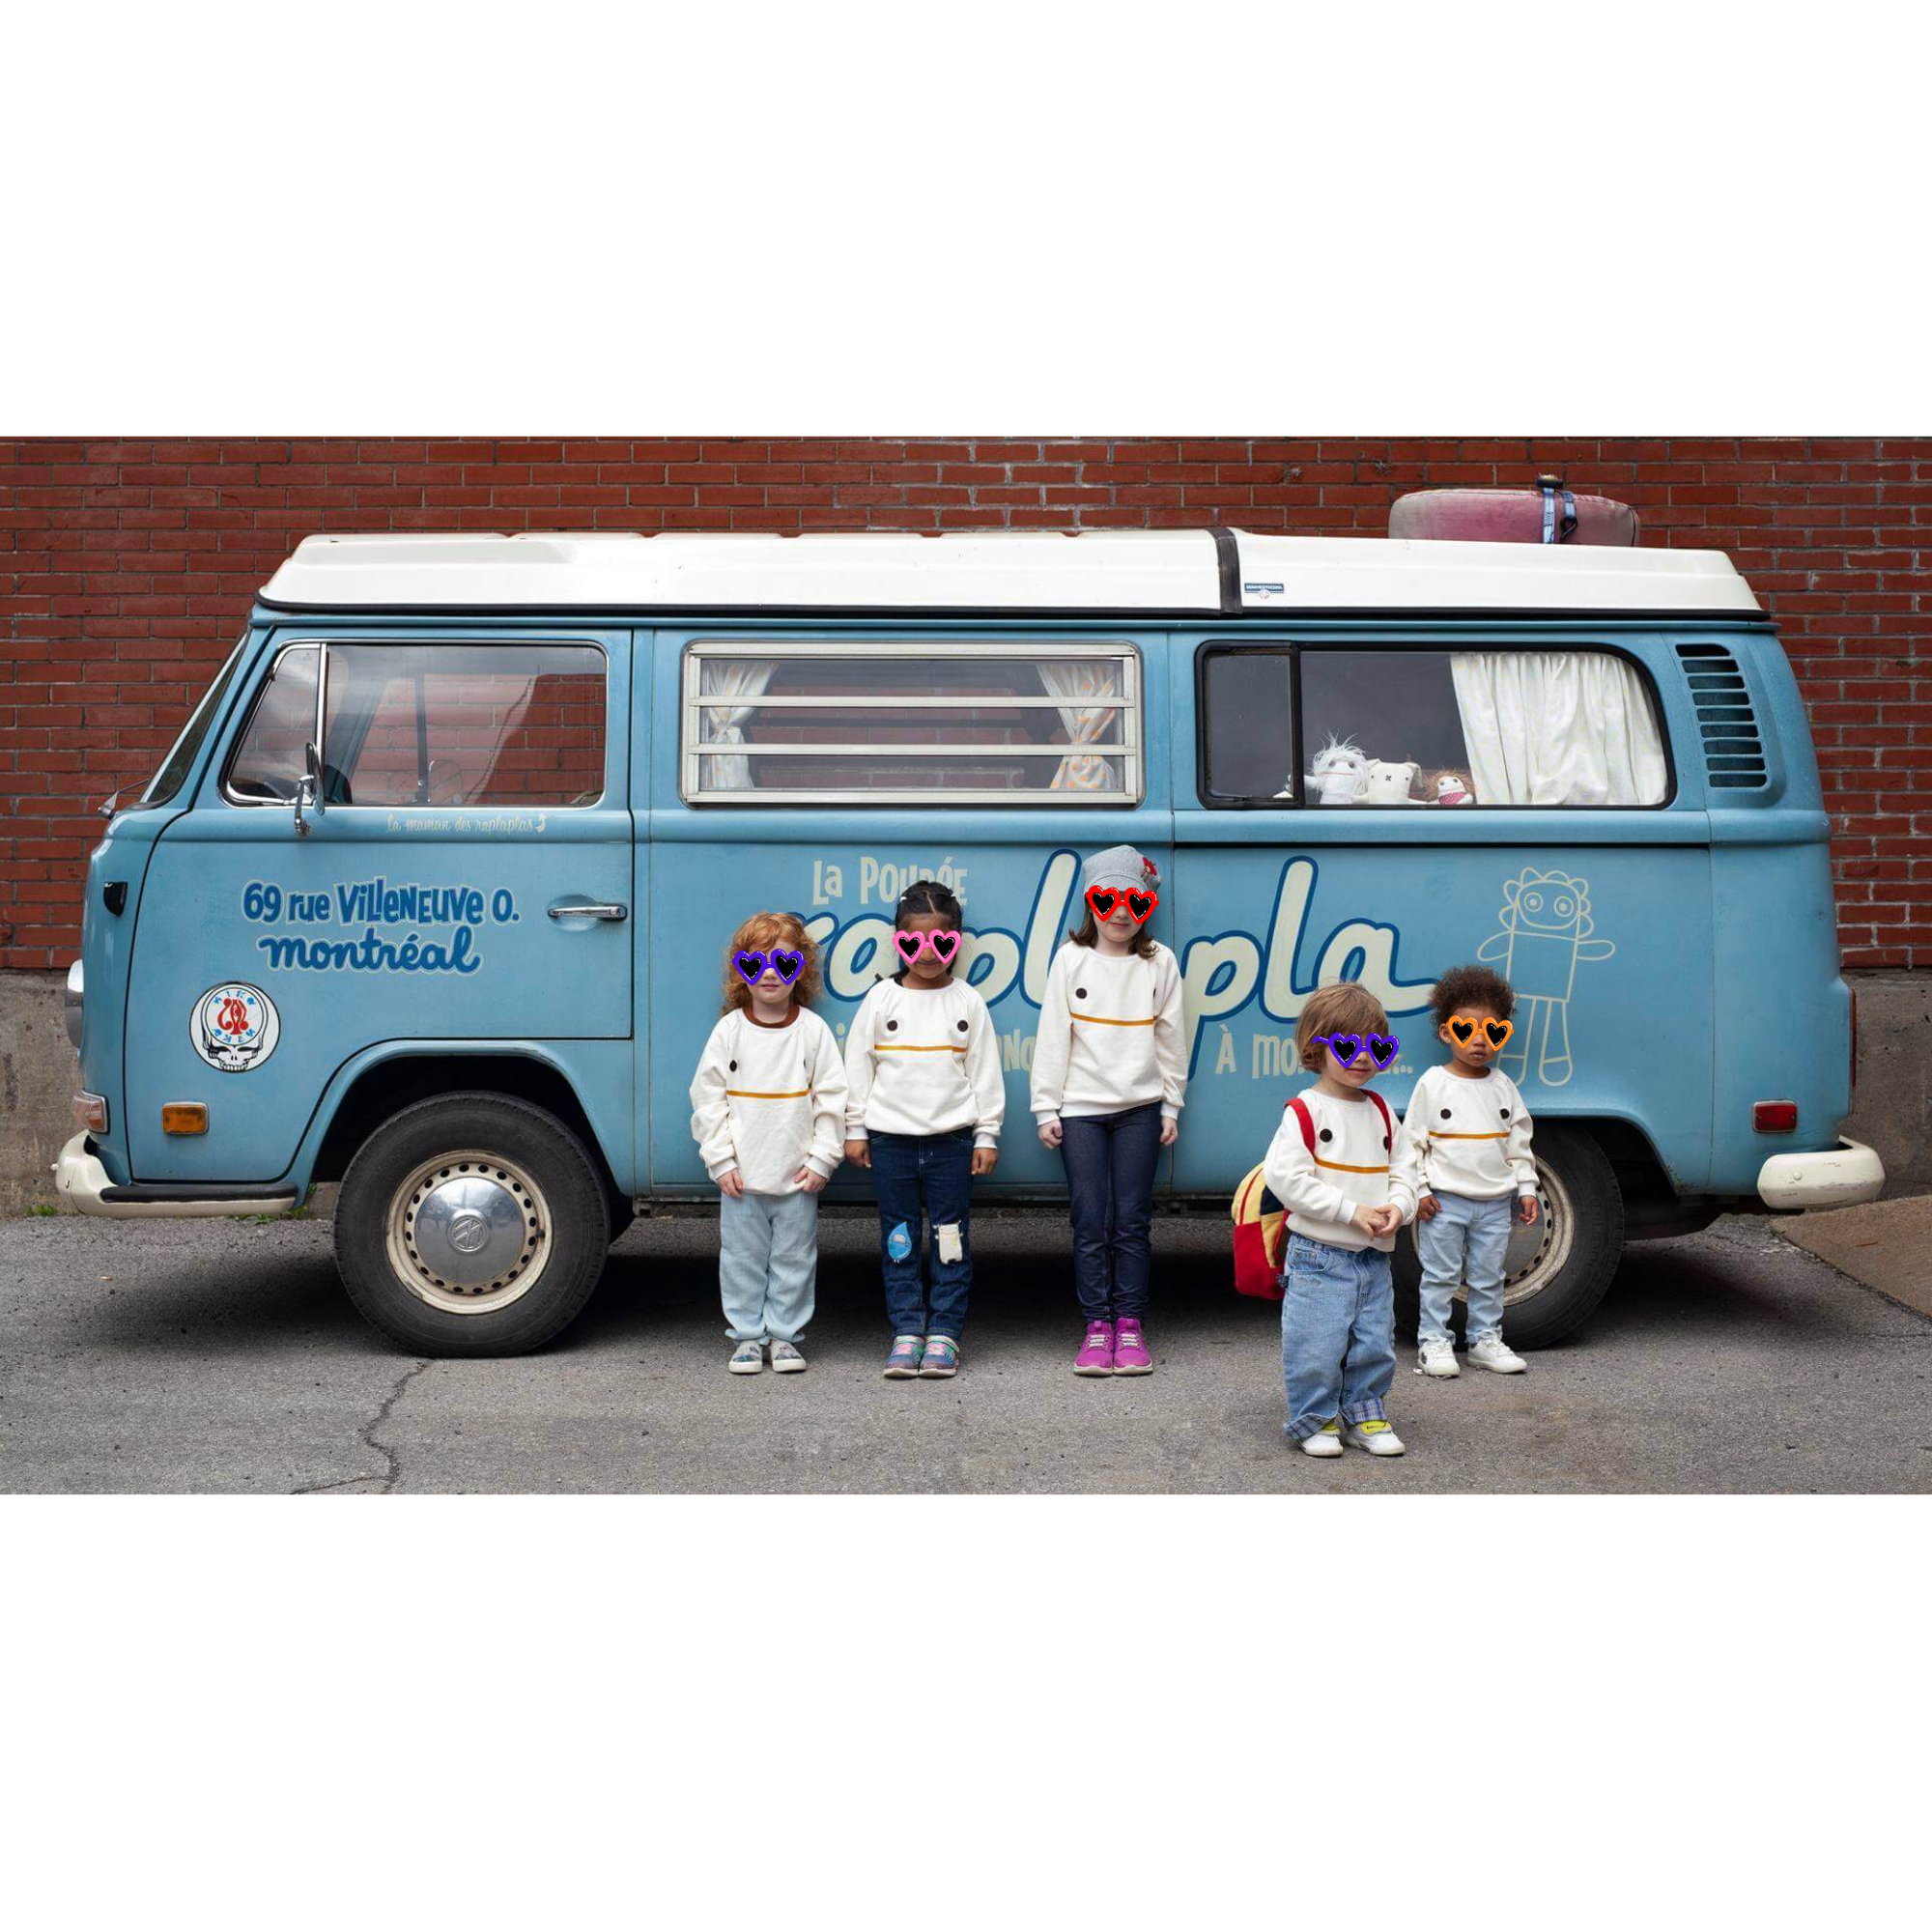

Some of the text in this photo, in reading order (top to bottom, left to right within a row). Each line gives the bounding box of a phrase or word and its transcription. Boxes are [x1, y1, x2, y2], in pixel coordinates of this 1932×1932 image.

[406, 819, 451, 832] maman
[454, 816, 472, 832] des
[242, 880, 284, 923] 69
[287, 891, 332, 923] rue
[812, 860, 843, 905] La
[256, 923, 483, 975] montréal
[1215, 1024, 1237, 1074] À
